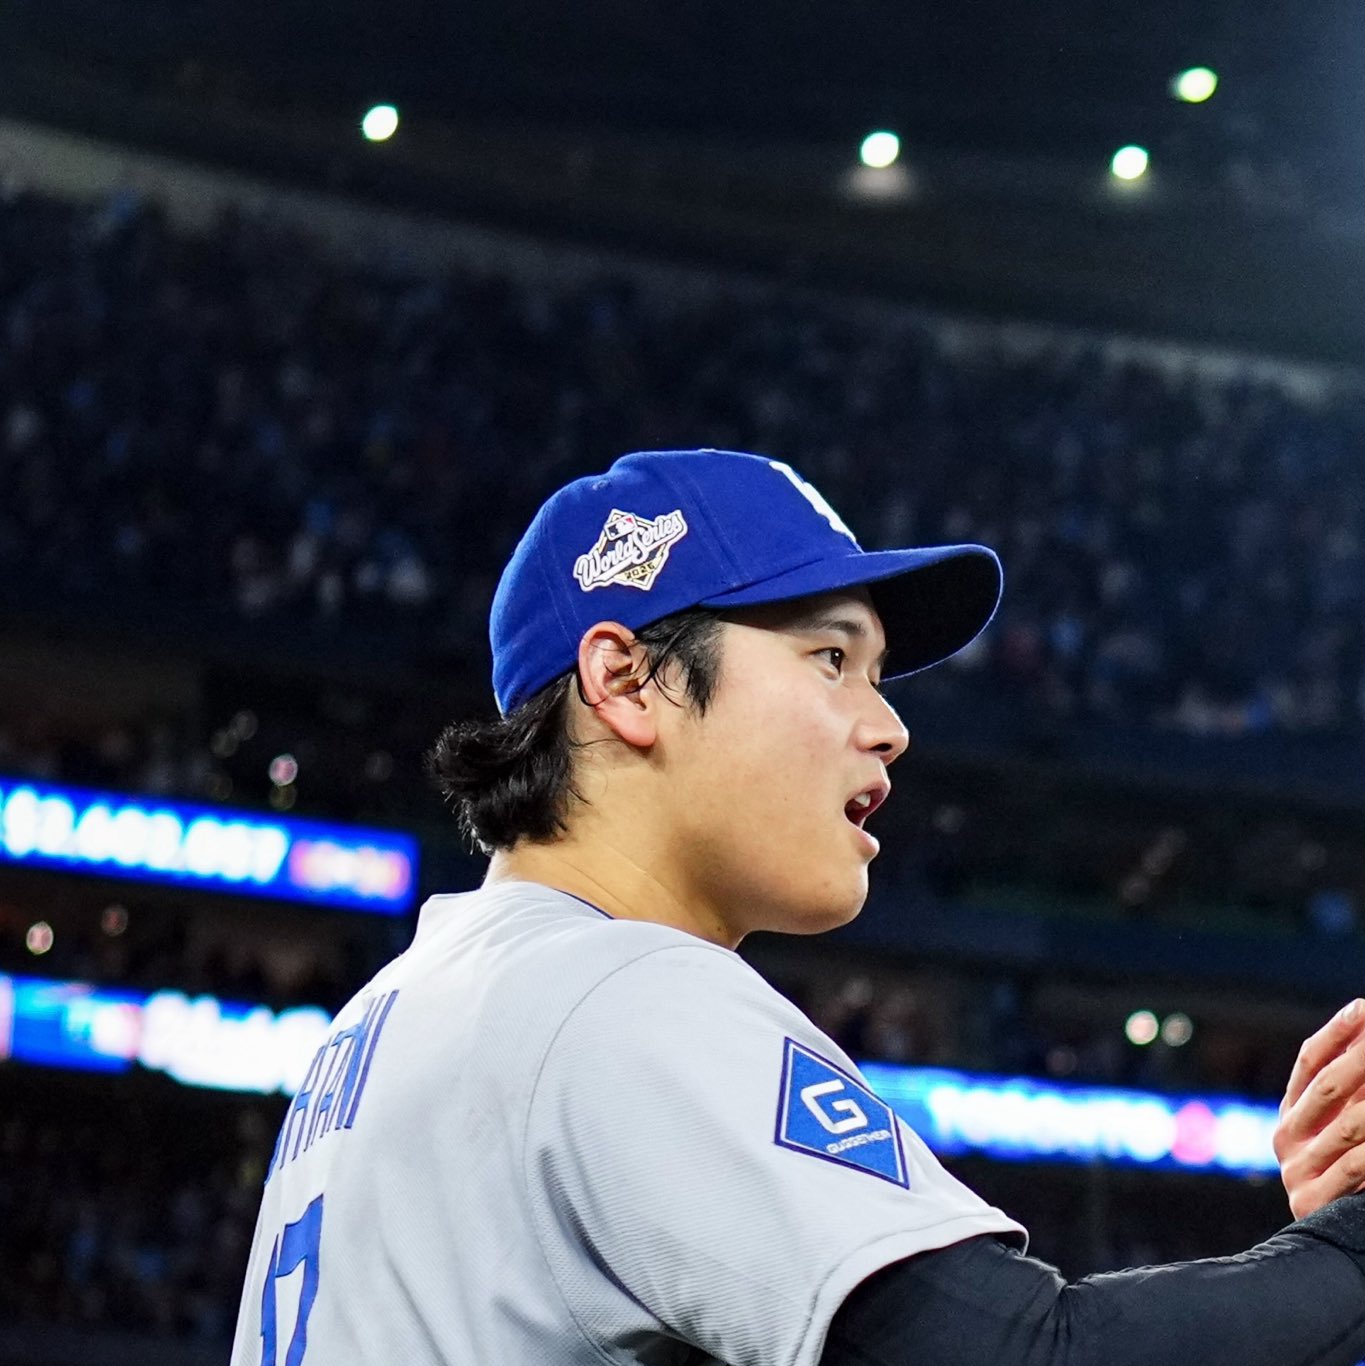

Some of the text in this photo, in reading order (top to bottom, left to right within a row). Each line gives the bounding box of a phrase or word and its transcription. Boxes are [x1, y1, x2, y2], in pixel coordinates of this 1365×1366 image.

[577, 512, 686, 587] World Series
[801, 1079, 868, 1134] G
